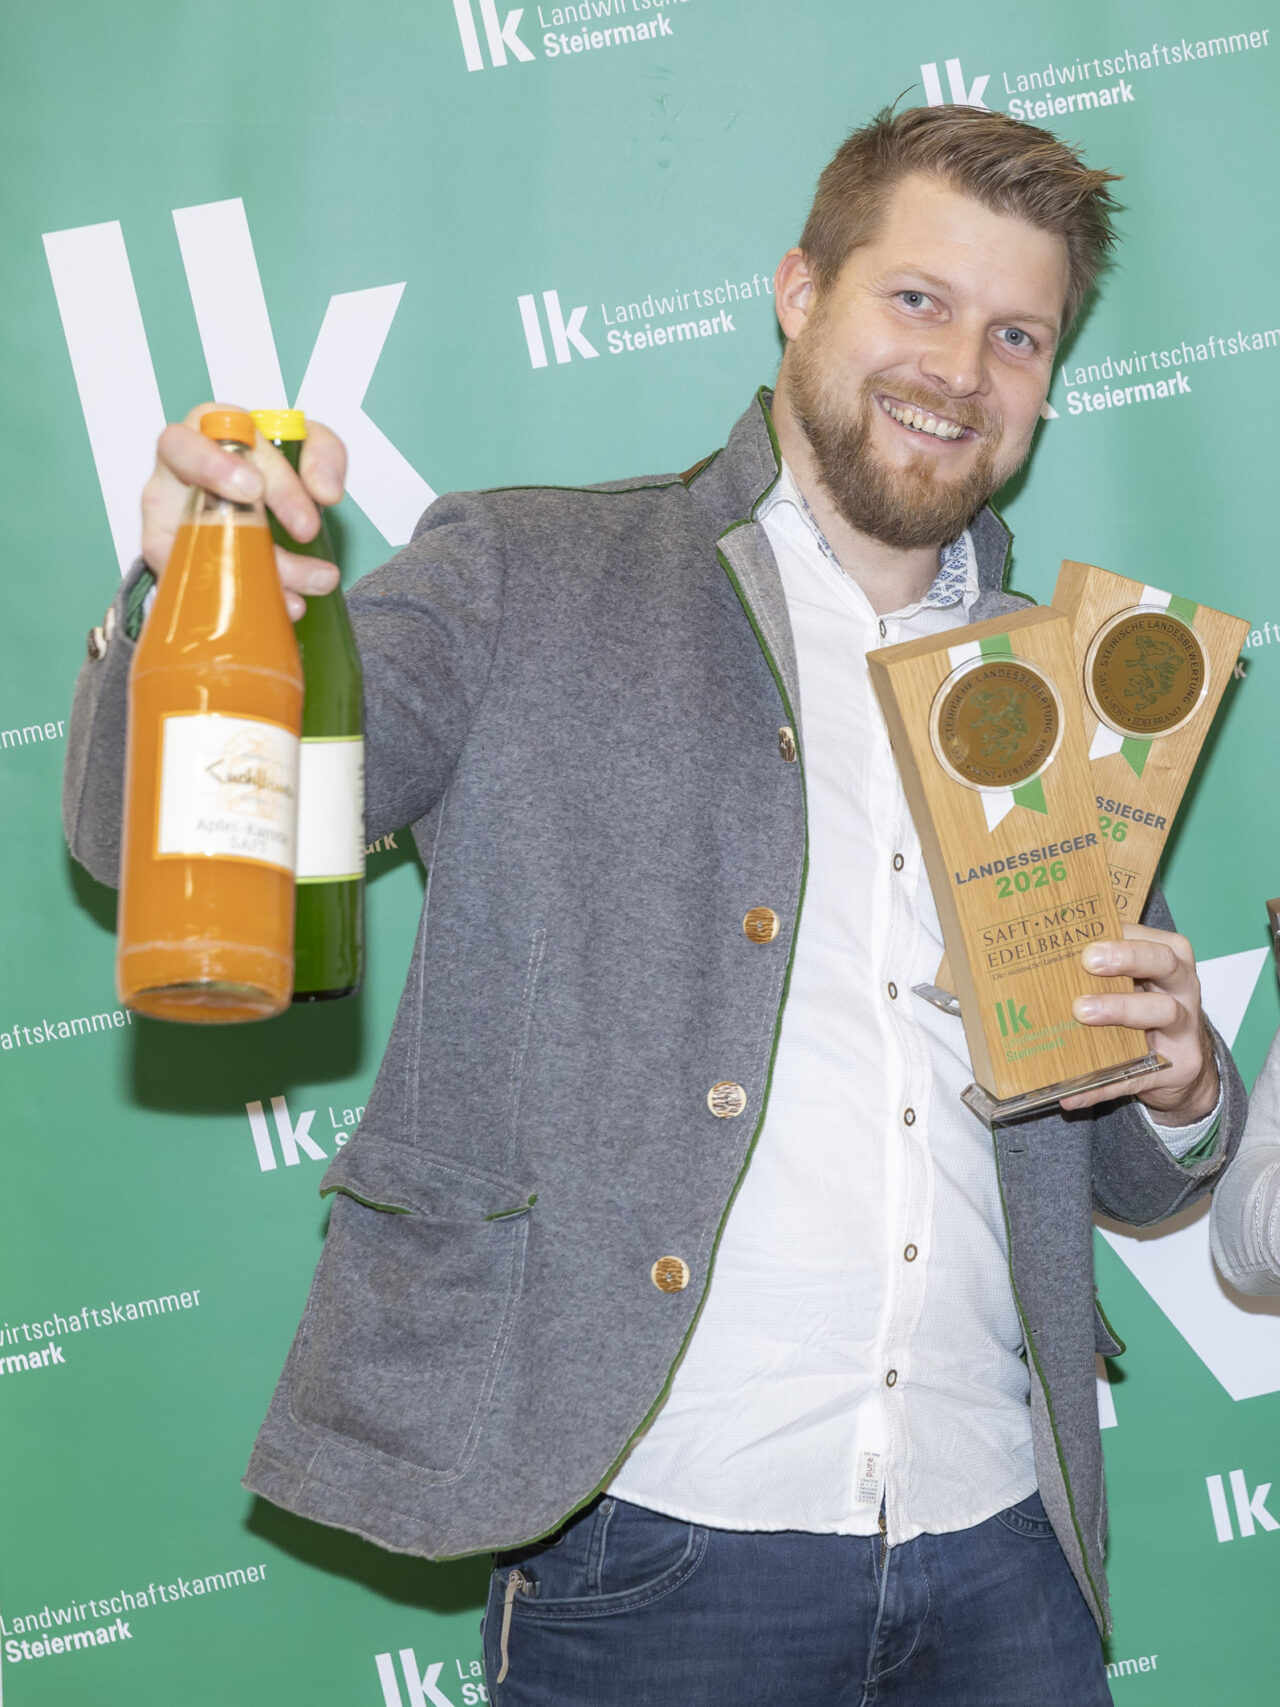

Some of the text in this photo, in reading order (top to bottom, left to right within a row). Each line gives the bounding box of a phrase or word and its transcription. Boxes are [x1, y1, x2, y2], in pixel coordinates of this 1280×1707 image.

[453, 0, 536, 72] lk
[543, 13, 673, 57] Steiermark
[1003, 29, 1270, 94] Landwirtschaftskammer
[920, 58, 992, 112] lk
[1008, 79, 1135, 122] Steiermark
[601, 272, 775, 326] Landwirtschaft
[517, 289, 600, 369] lk
[606, 309, 736, 354] Steiermark
[1066, 371, 1192, 415] Steiermark
[1147, 620, 1200, 704] LANDESBEWERTUNG
[975, 669, 1054, 734] LANDESBEWERTUNG
[955, 832, 1098, 885] LANDESSIEGER
[995, 860, 1067, 900] 2026
[982, 920, 1031, 946] SAFT
[1044, 899, 1099, 931] MOST
[987, 921, 1105, 968] EDELBRAND
[995, 998, 1032, 1037] lk
[245, 1095, 328, 1172] lk
[0, 1564, 268, 1636] Landwirtschaftskammer
[4, 1618, 133, 1663] Steiermark
[375, 1648, 455, 1707] lk
